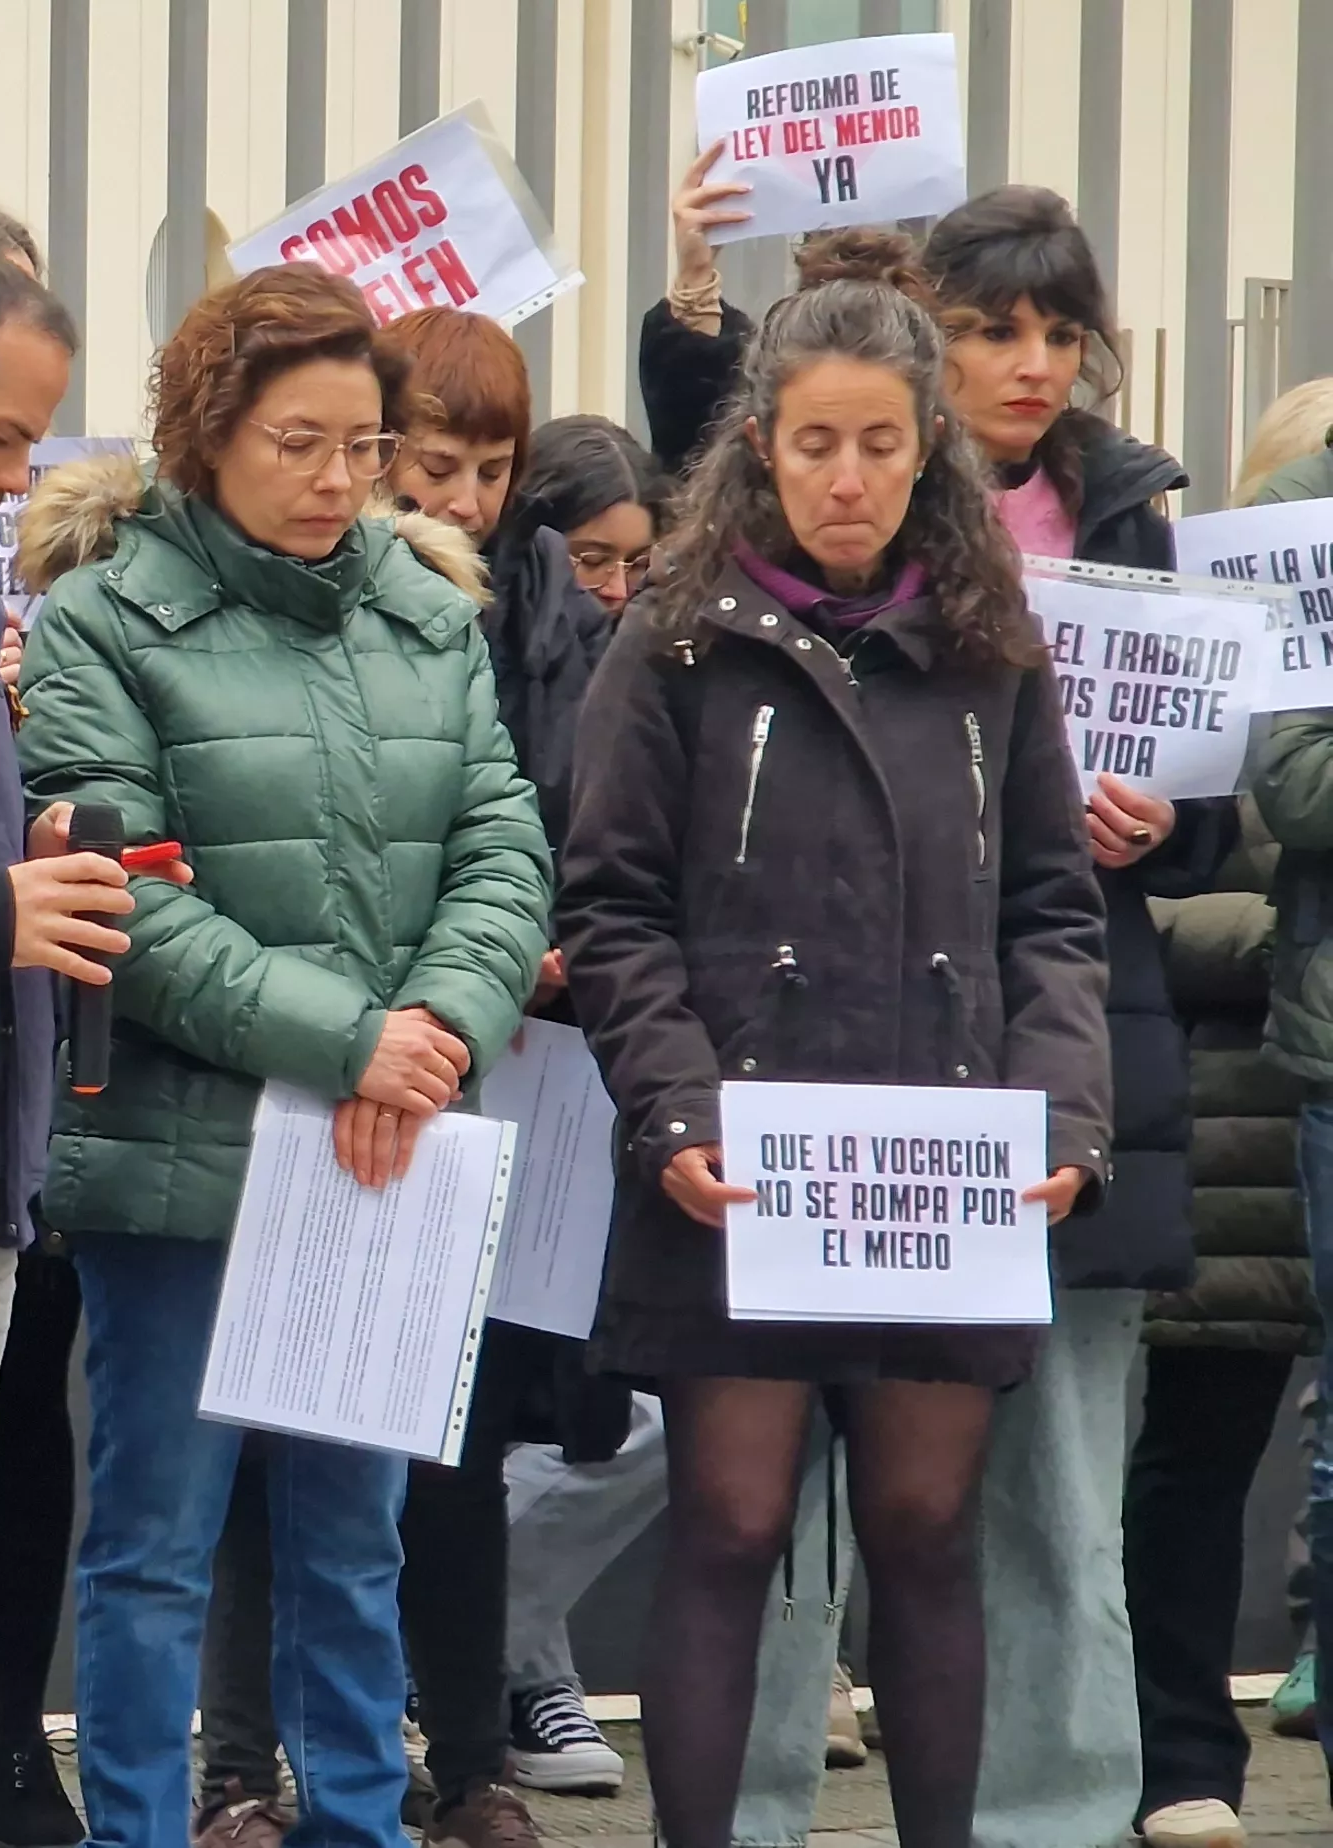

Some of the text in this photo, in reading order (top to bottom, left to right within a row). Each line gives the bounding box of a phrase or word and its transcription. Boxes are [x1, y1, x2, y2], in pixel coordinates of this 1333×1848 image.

[747, 68, 901, 120] REFORMA DE
[733, 105, 921, 161] LEY DEL MENOR
[812, 155, 858, 204] YA
[363, 238, 480, 329] ELÉN
[1270, 548, 1302, 584] LA
[1310, 542, 1333, 579] V
[1054, 621, 1242, 685] EL TRABAJO
[1283, 635, 1312, 672] EL
[1058, 674, 1229, 733] OS CUESTE
[1083, 729, 1157, 778] VIDA
[760, 1133, 1010, 1180] QUE LA VOCACIÓN
[756, 1179, 1017, 1227] NO SE ROMPA POR
[823, 1228, 951, 1271] EL MIEDO
